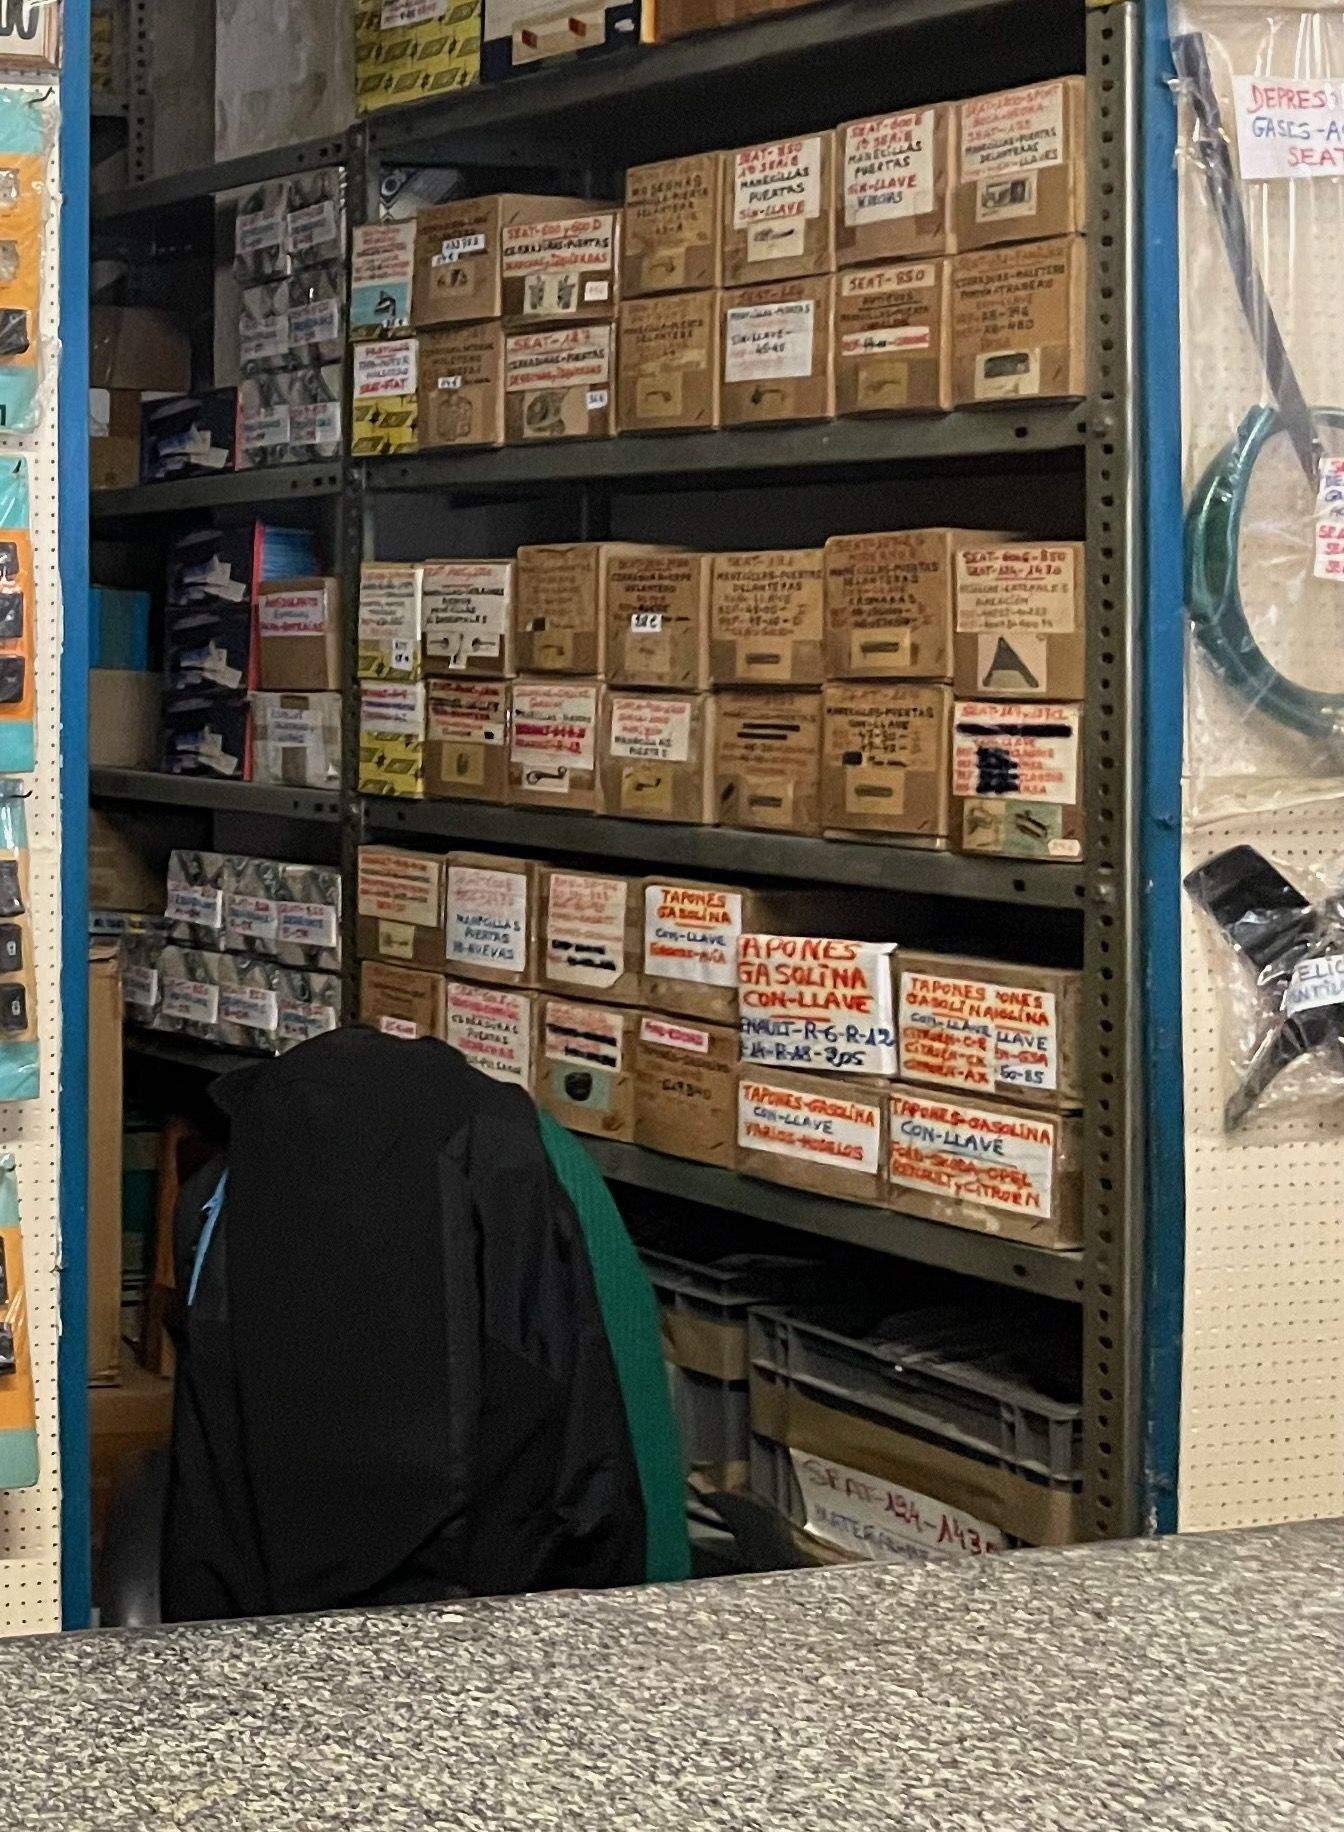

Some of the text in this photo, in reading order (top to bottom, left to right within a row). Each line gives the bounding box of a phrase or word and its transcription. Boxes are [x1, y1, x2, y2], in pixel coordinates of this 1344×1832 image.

[661, 889, 727, 908] TAPONES
[741, 938, 858, 961] APONES
[911, 977, 986, 1002] TAPONES
